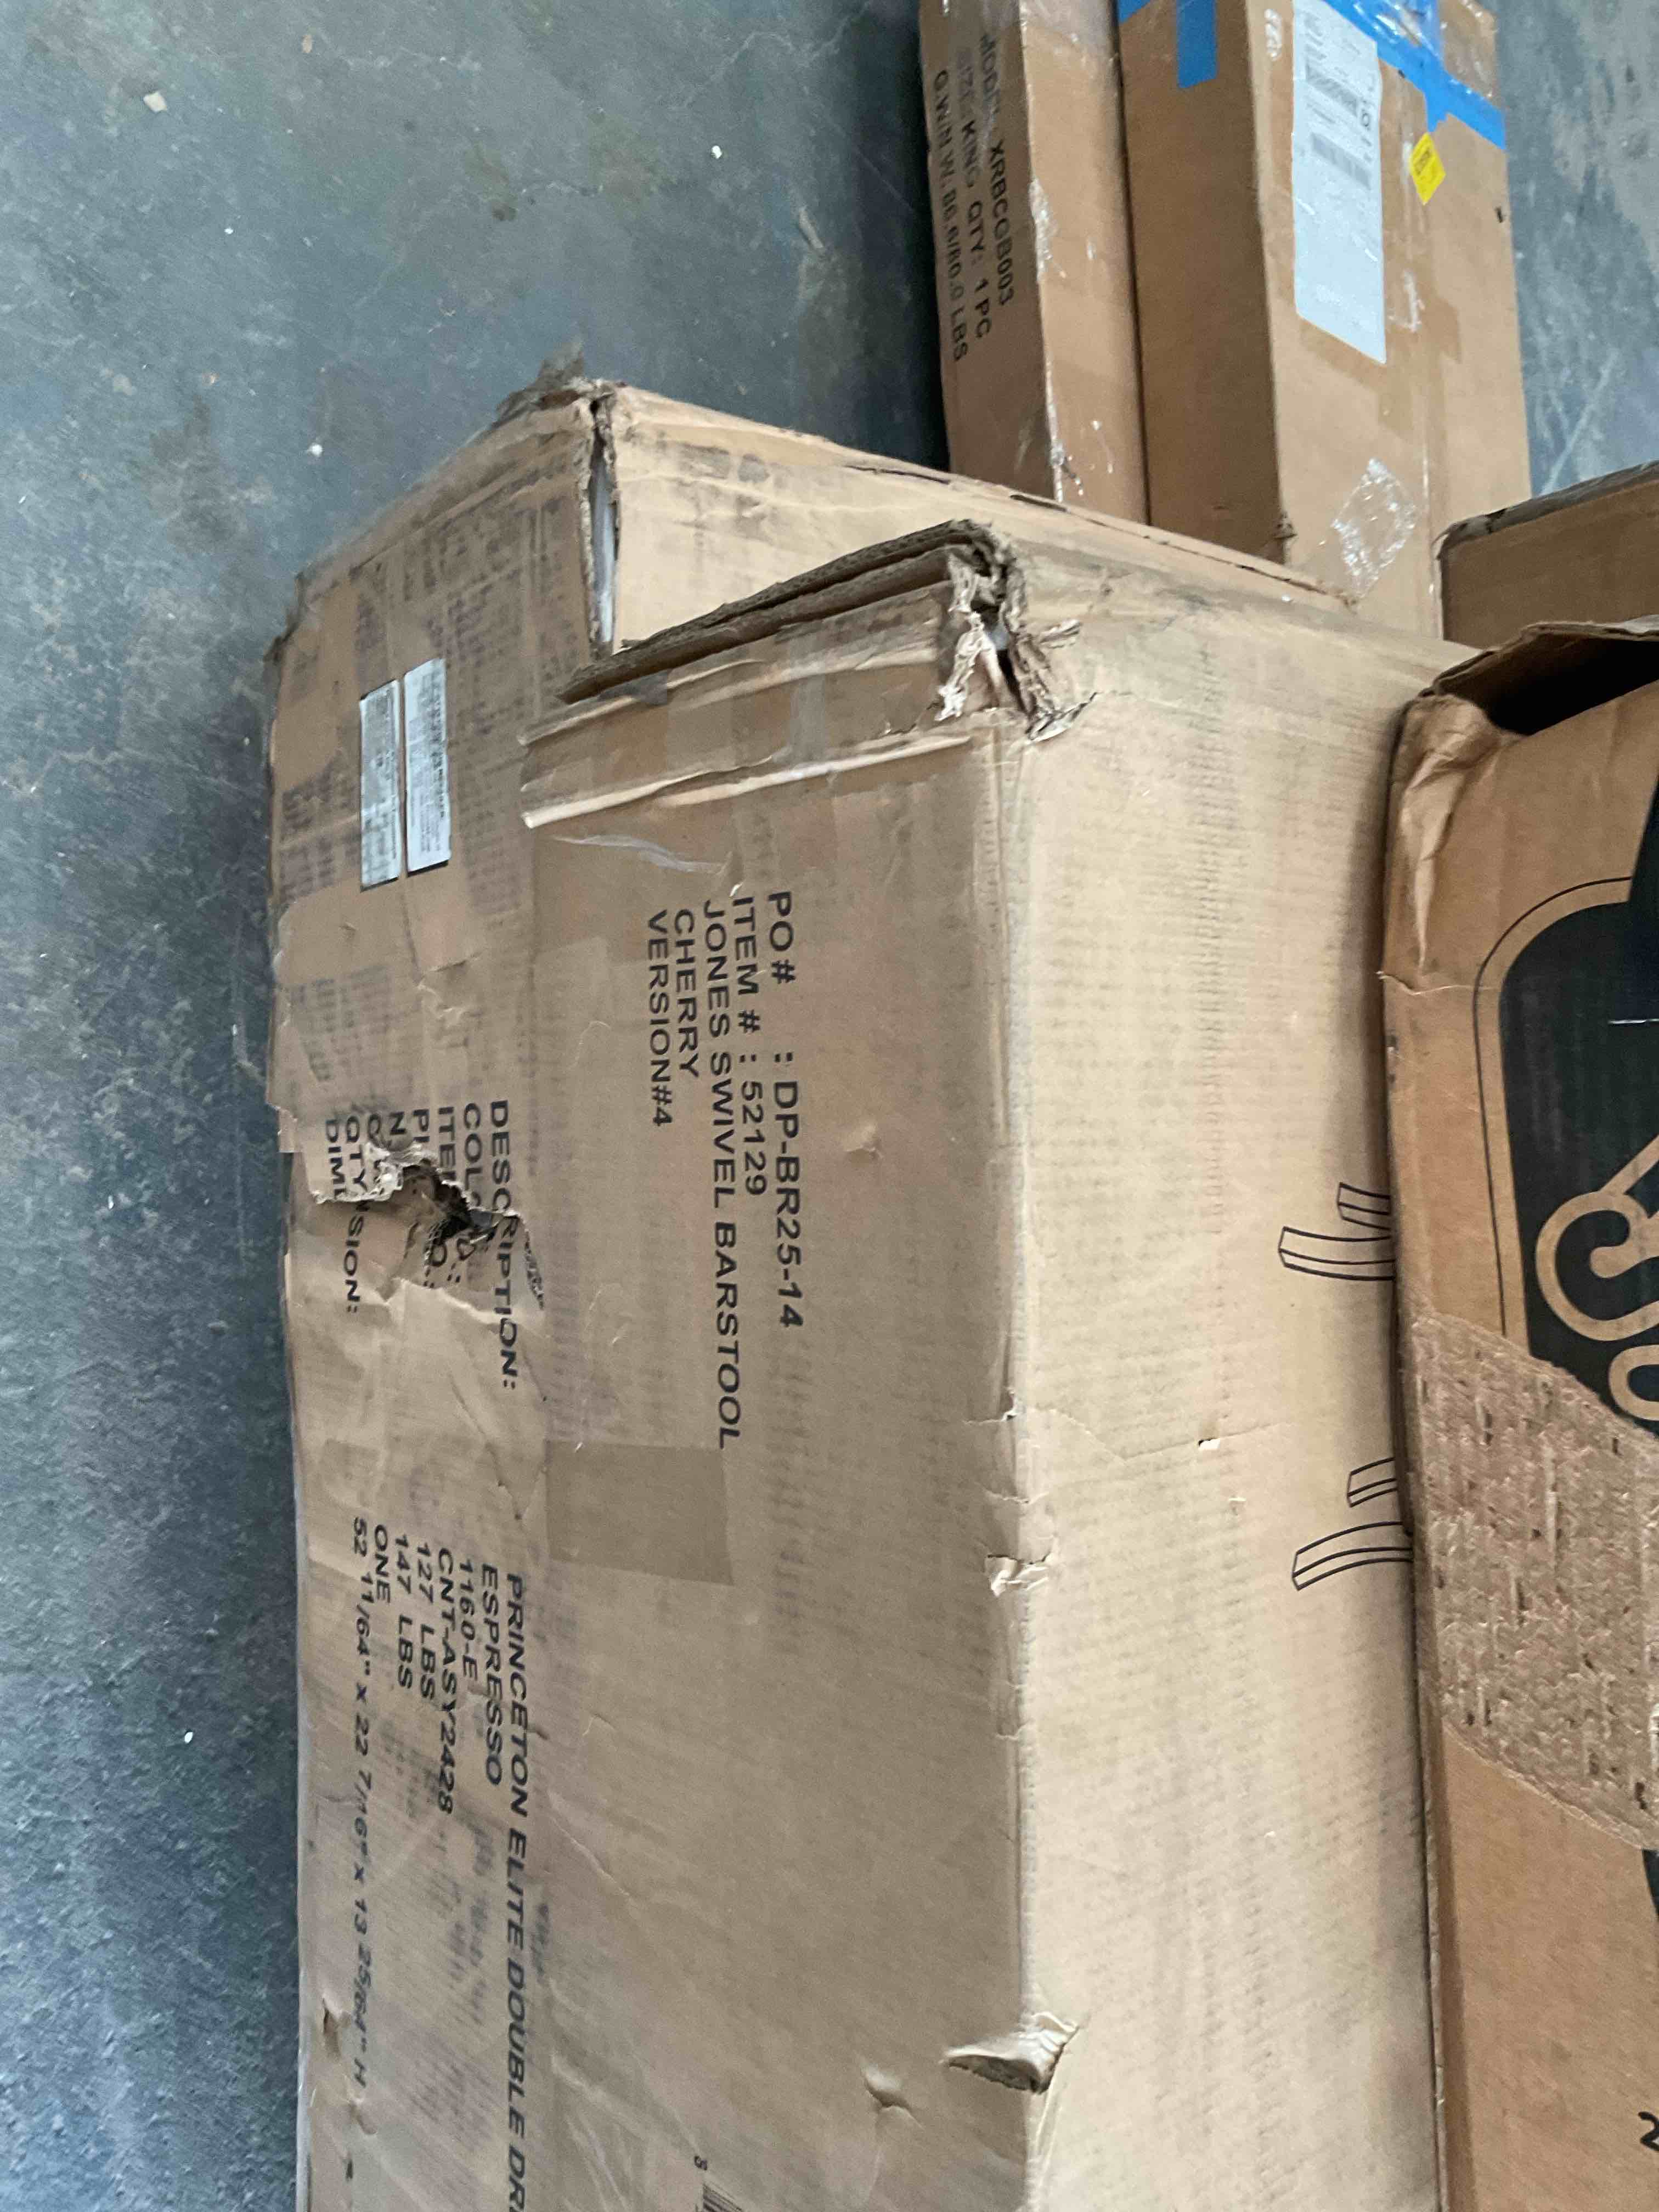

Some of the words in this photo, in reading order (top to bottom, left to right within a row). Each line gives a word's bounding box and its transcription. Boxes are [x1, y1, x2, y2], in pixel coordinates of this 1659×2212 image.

[961, 119, 981, 188] KING
[951, 306, 969, 362] LBS
[674, 909, 698, 1078] CHERRY
[703, 900, 729, 1037] JONES
[732, 896, 759, 995] ITEM
[648, 910, 673, 1126] VERSION#4
[711, 1052, 735, 1207] SWIVEL
[741, 1081, 766, 1195] 52129
[774, 1081, 803, 1328] DP-BR25-14
[714, 1221, 741, 1449] BARSTOOL
[353, 1516, 368, 1557] 52
[374, 1525, 391, 1603] ONE
[396, 1534, 411, 1594] 147
[417, 1542, 433, 1603] 127
[398, 1615, 413, 1689] LBS
[420, 1624, 436, 1700] LBS
[459, 1559, 478, 1681] 1160-E
[482, 1564, 502, 1785] ESPRESSO
[354, 1713, 369, 1756] 22
[437, 1548, 456, 1814] CNT-ASY2428
[507, 1573, 527, 1817] PRINCETON
[354, 1899, 368, 1936] 13
[507, 1829, 526, 1950] ELITE
[507, 1957, 525, 2138] DOUBLE
[509, 2145, 526, 2212] DR
